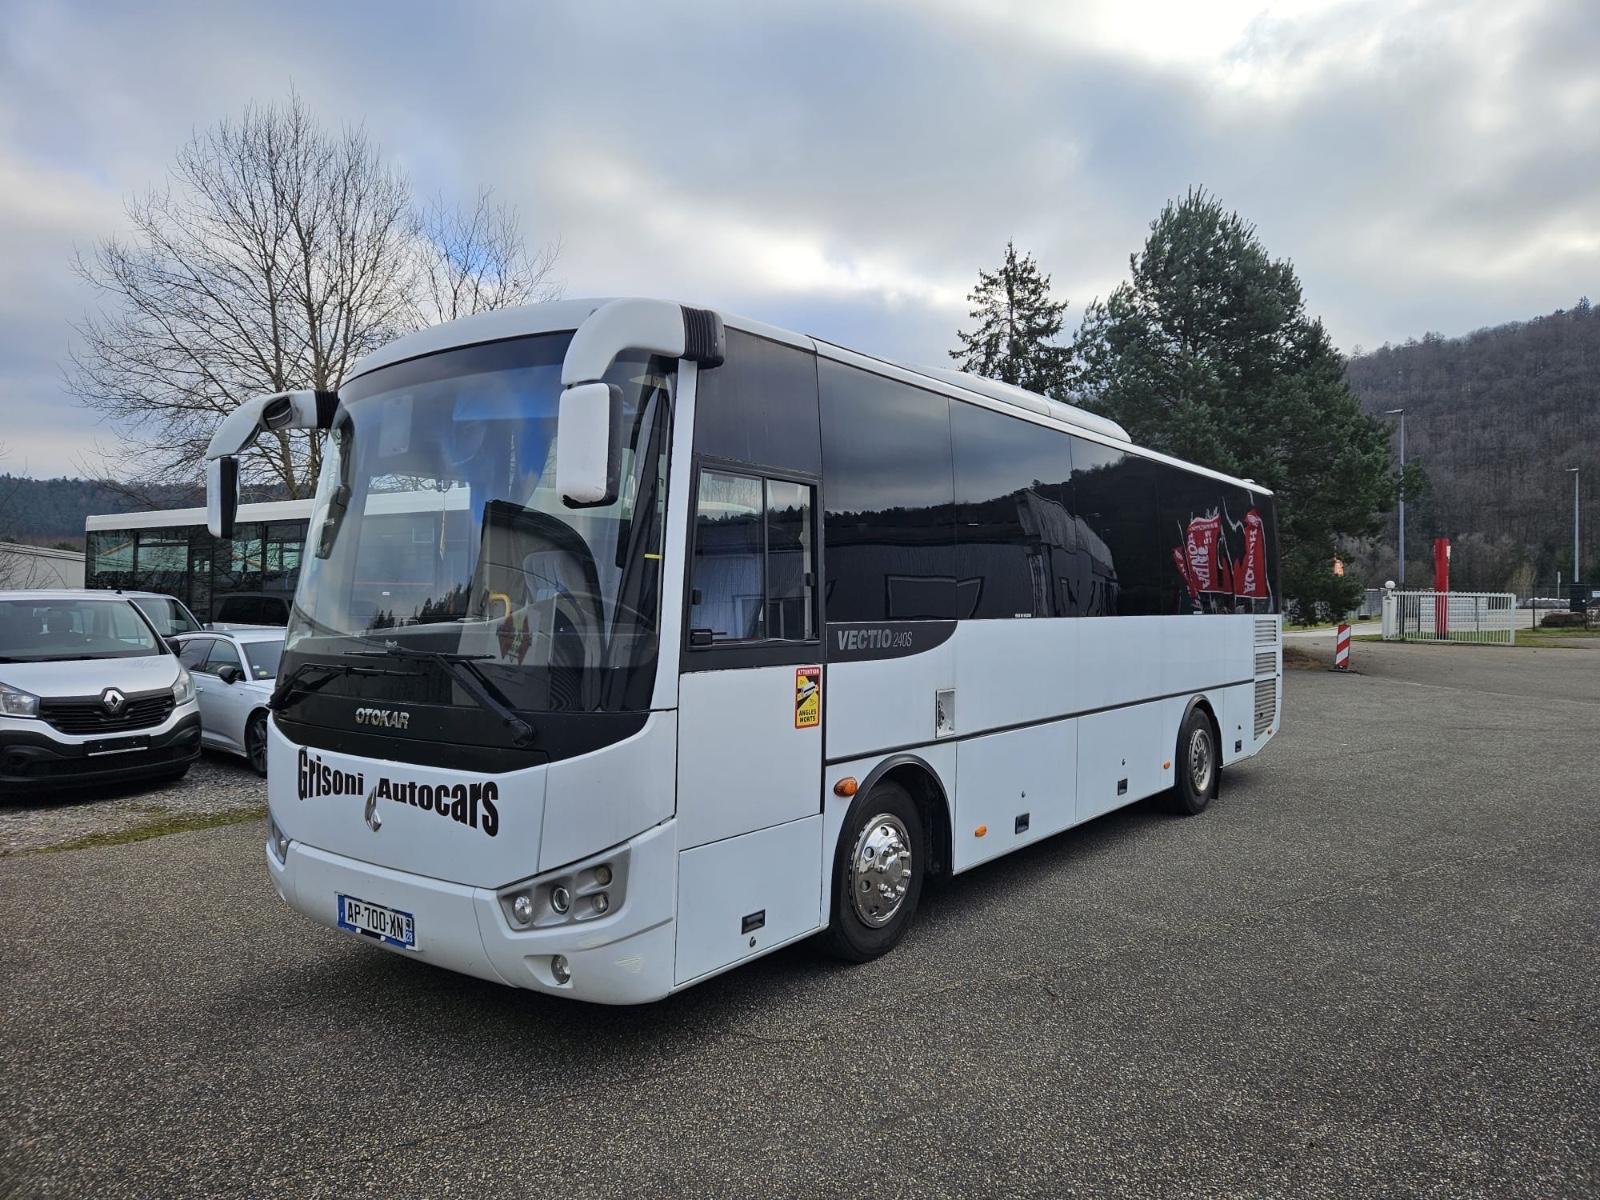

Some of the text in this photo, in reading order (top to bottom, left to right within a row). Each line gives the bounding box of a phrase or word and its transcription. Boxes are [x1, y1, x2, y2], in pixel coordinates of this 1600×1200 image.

[838, 629, 913, 650] VECTIO 240S
[355, 707, 410, 729] OTOKAR
[298, 746, 499, 837] Grisoni Autocars
